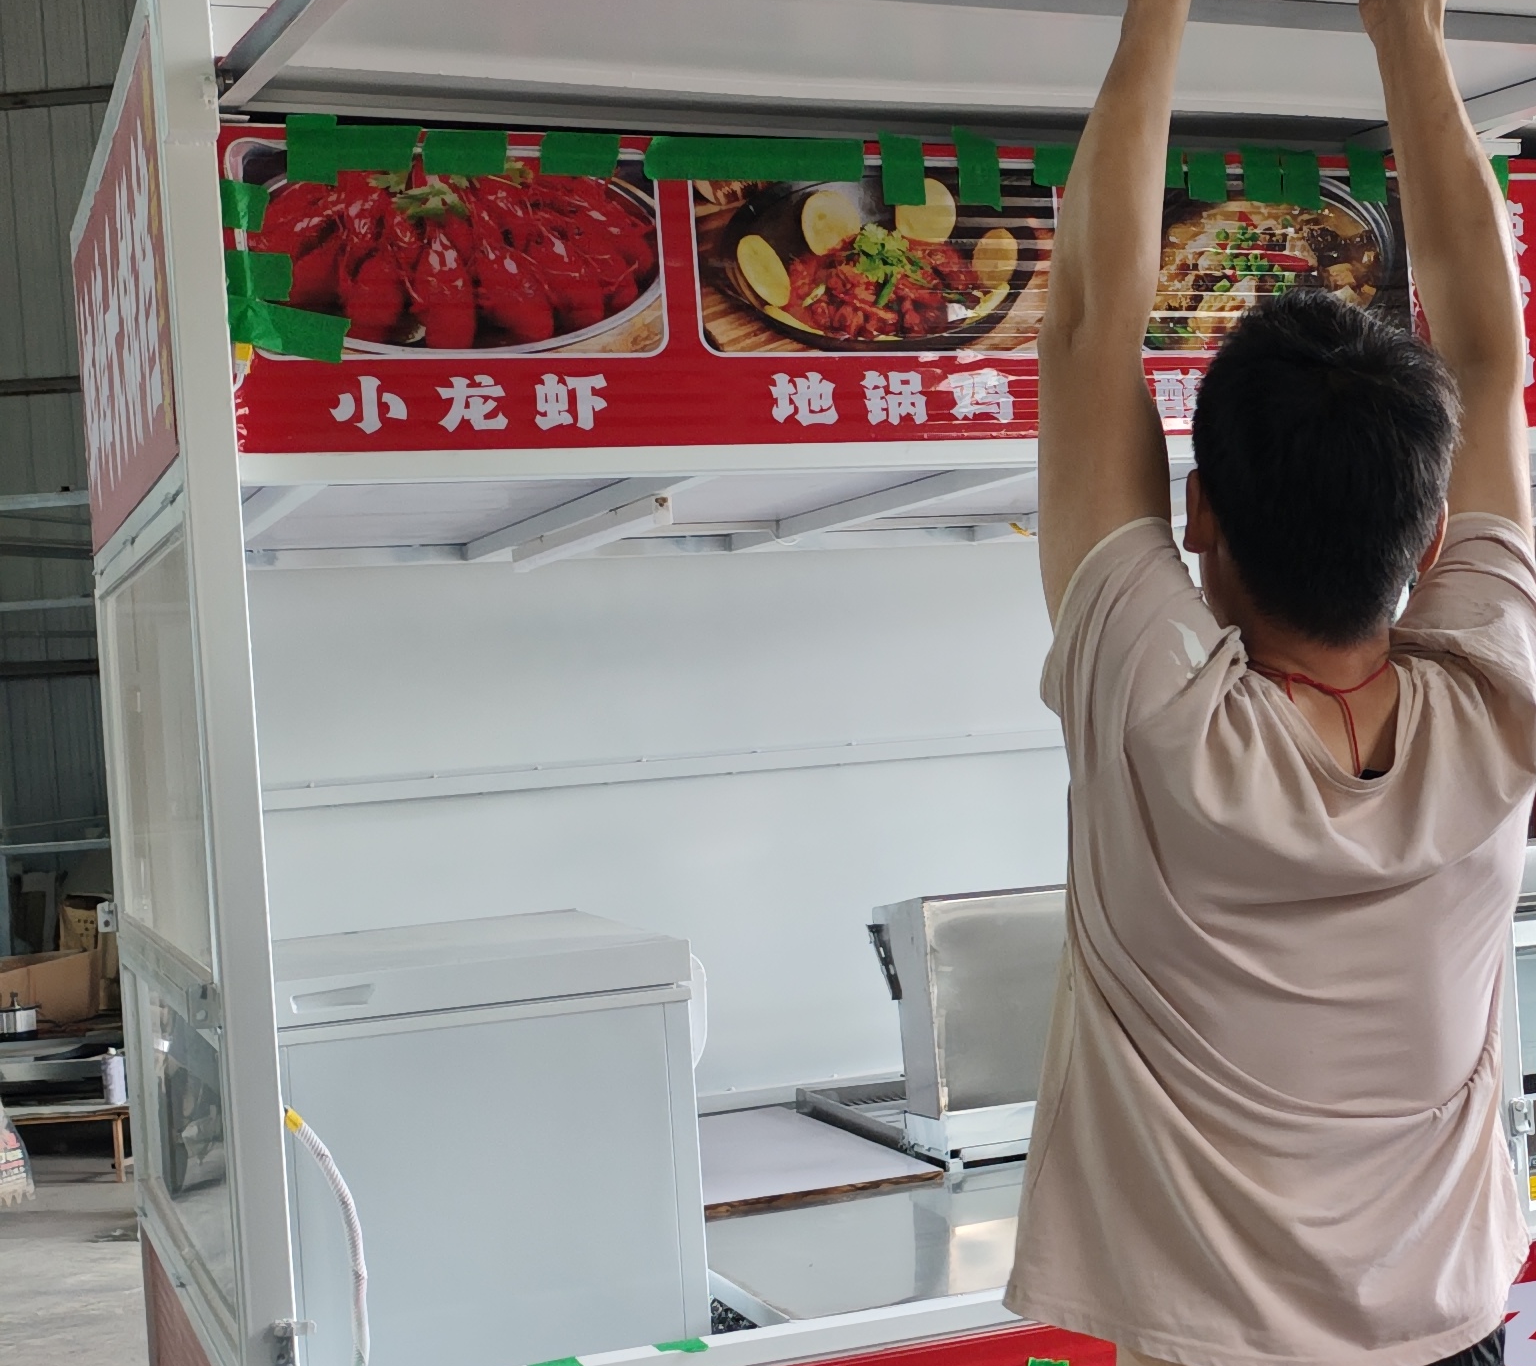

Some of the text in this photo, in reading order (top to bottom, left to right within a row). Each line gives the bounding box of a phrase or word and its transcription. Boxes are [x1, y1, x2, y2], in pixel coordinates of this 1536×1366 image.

[330, 373, 609, 435] 小龙虾
[768, 368, 1015, 427] 地锅鸡
